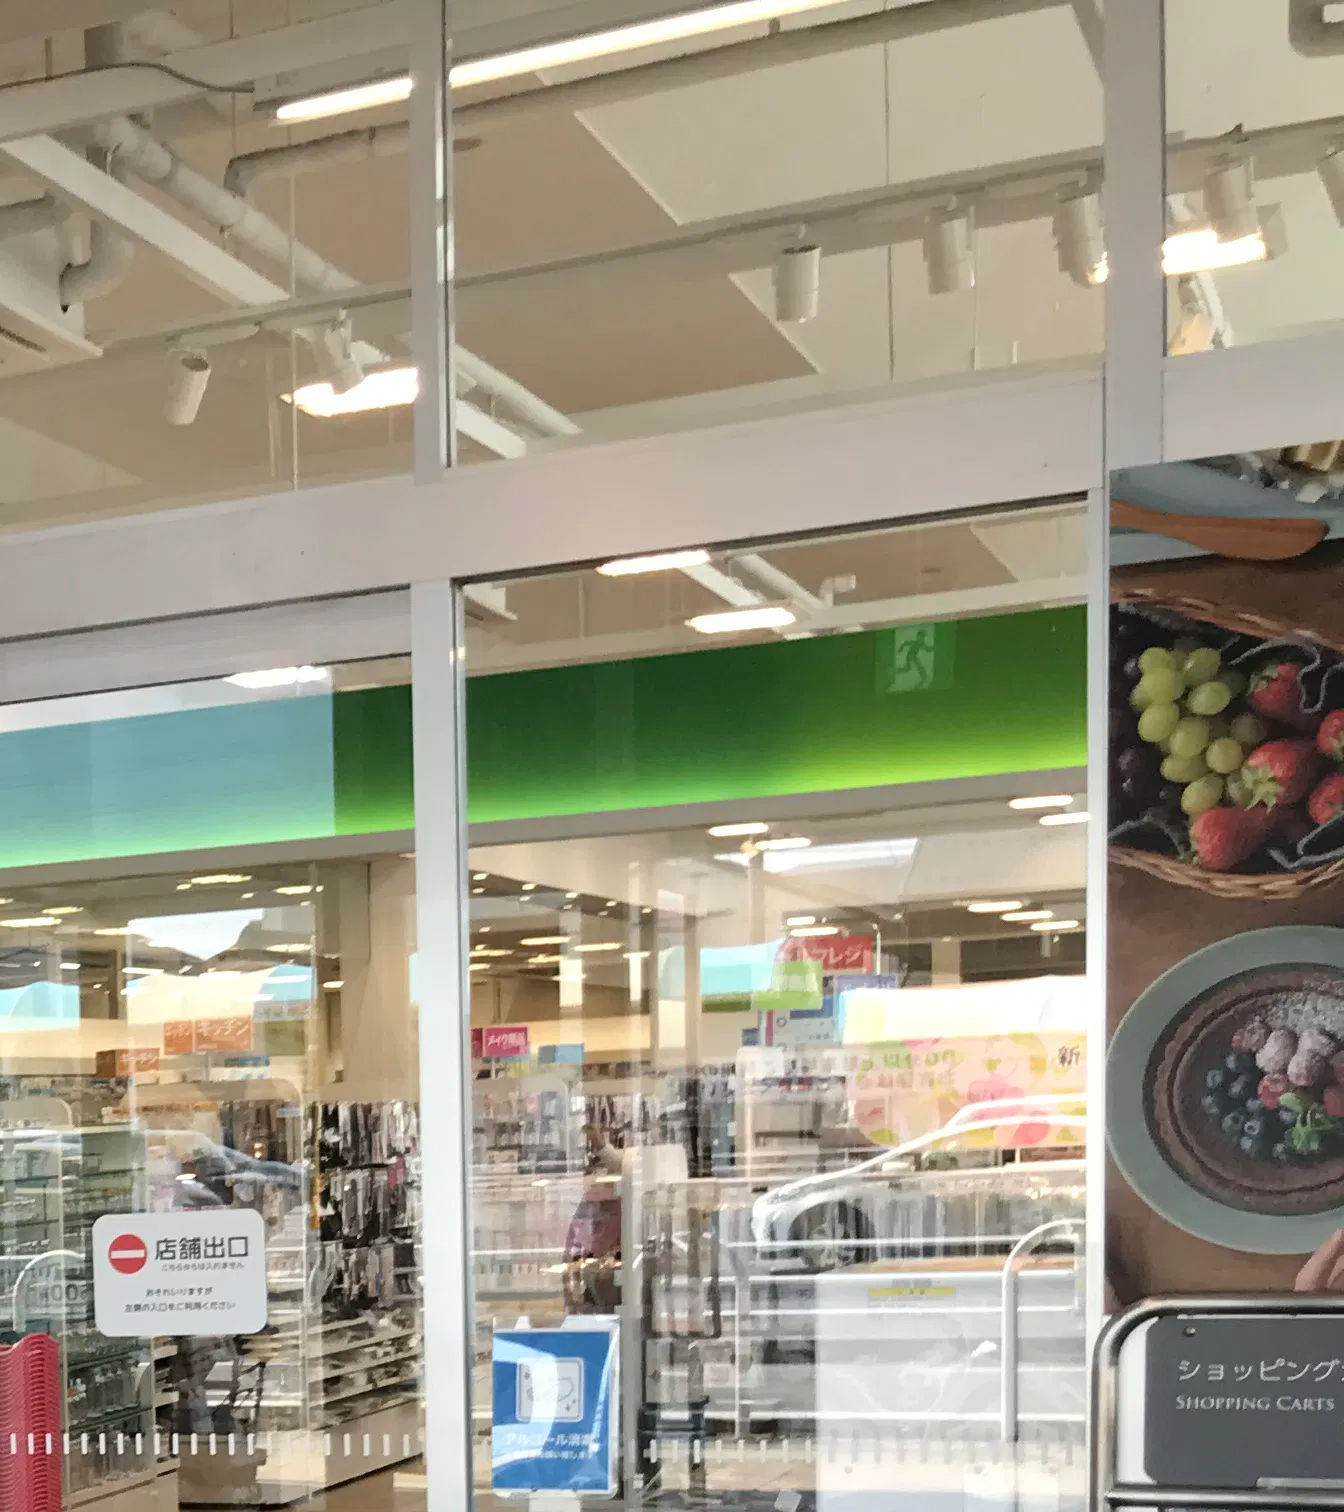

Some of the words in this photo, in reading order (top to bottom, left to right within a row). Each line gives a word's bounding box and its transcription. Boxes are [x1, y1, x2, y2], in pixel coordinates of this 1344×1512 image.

[197, 1020, 249, 1037] キッチン
[155, 1236, 249, 1261] 店舗出口
[145, 1287, 213, 1298] おそれいりますが
[1178, 1358, 1344, 1382] ショッピング
[1176, 1395, 1271, 1411] SHOPPING
[1276, 1396, 1335, 1411] CARTS
